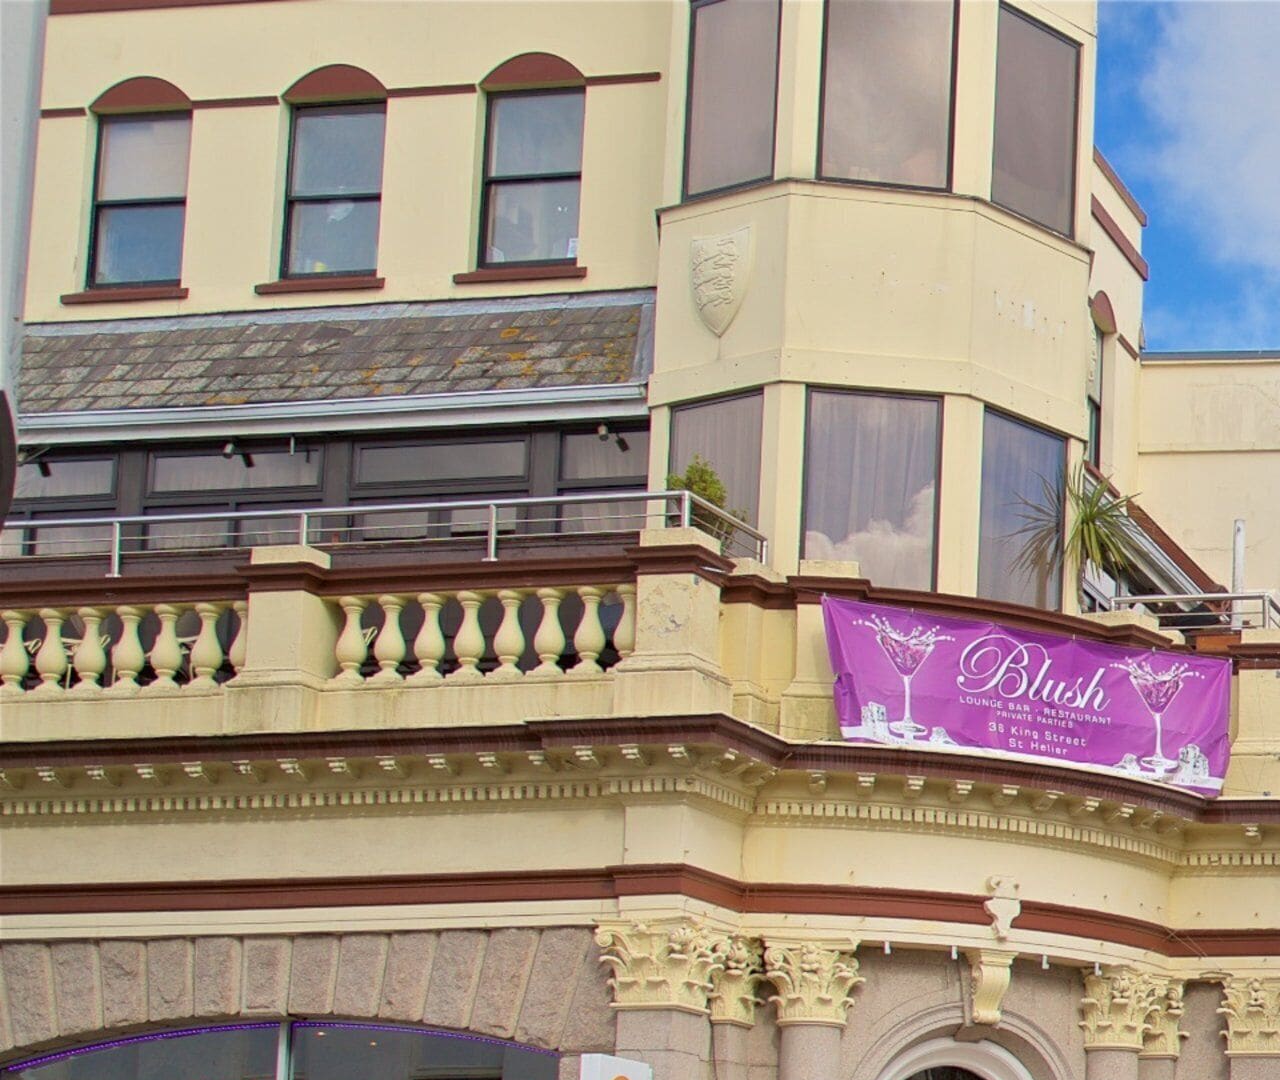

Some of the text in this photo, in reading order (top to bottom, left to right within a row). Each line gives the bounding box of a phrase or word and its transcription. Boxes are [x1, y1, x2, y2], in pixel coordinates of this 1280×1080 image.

[957, 634, 1112, 712] Blush
[959, 695, 1112, 725] LOUNGE BAR RESTAURANT
[996, 710, 1074, 729] PRIVATE PARTIES
[1008, 738, 1068, 755] St Helier
[1011, 726, 1039, 739] King
[1044, 731, 1087, 747] Street
